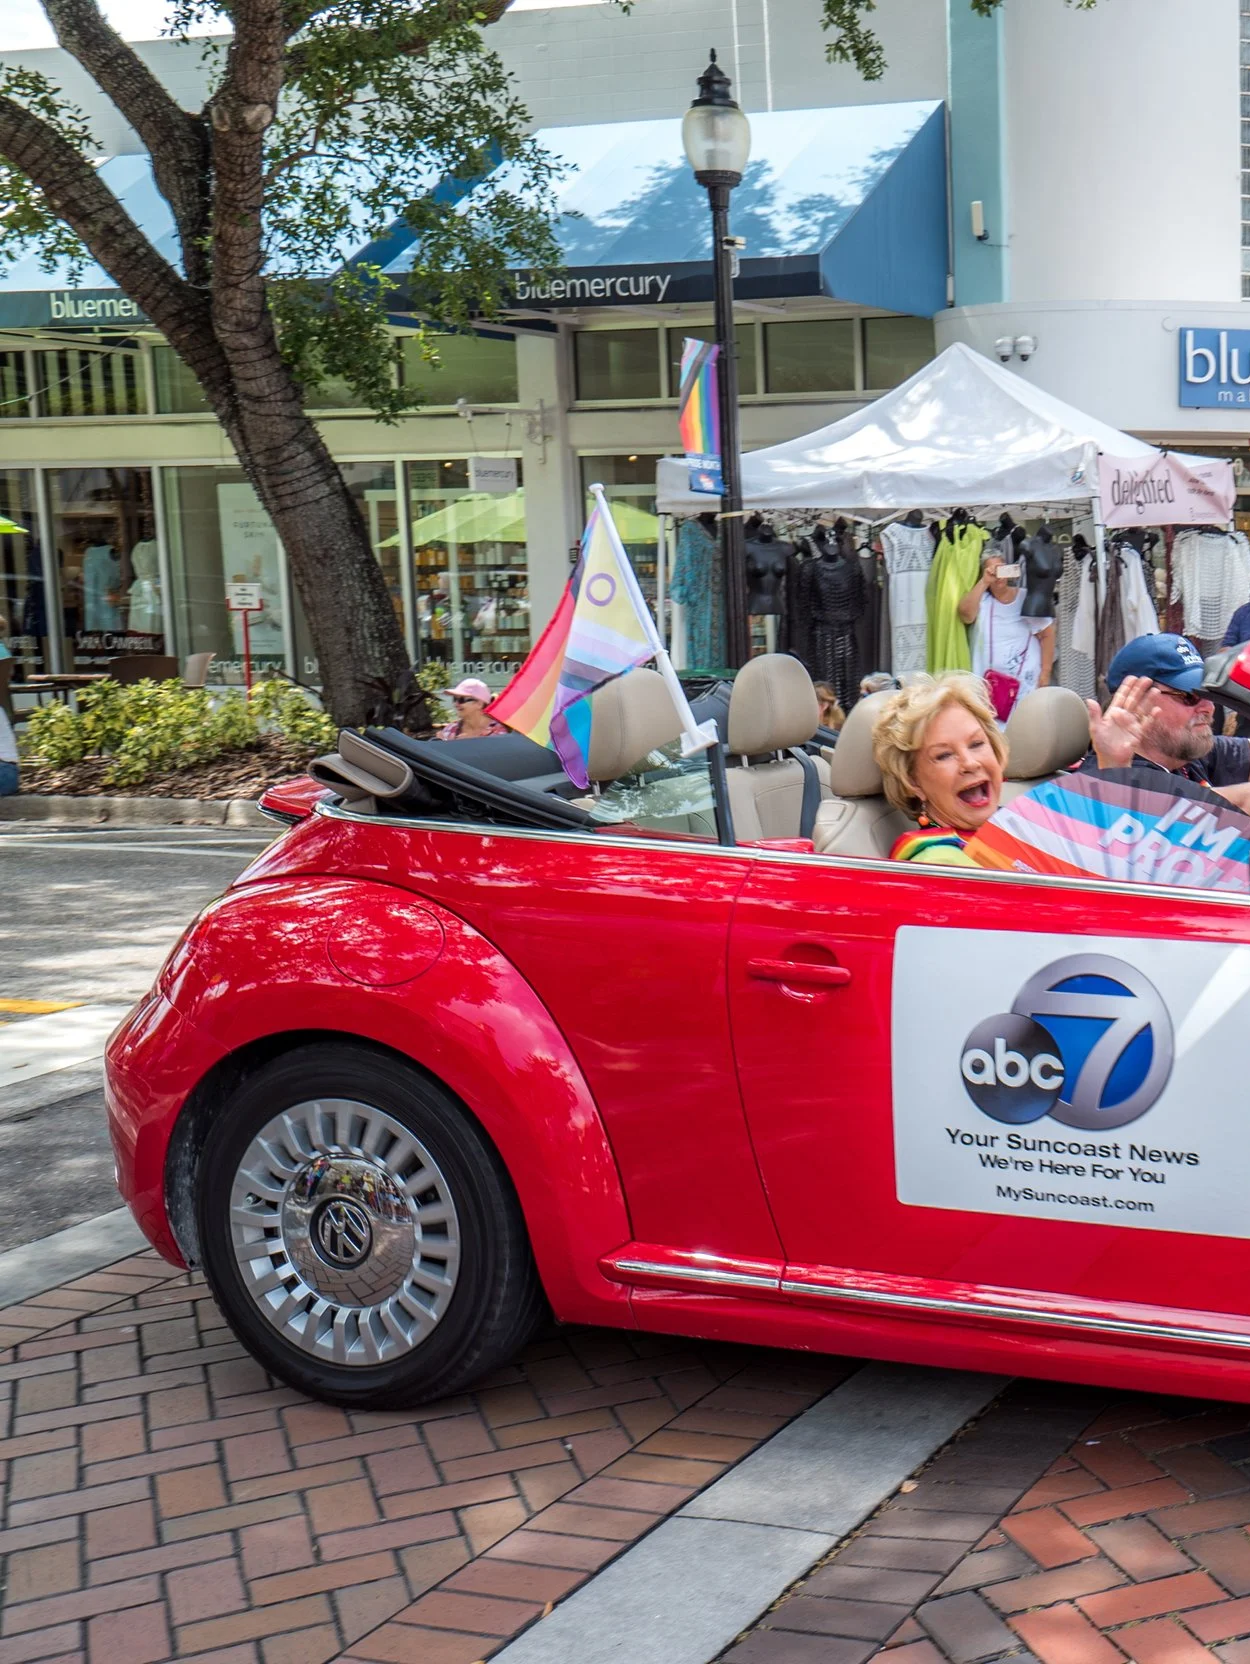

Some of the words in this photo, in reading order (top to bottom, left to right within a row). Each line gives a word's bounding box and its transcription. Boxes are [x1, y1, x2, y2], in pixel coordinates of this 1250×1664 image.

[1154, 797, 1242, 862] I'M
[961, 1037, 1065, 1090] abc
[1020, 983, 1160, 1117] 7
[945, 1128, 1000, 1148] Your
[1006, 1133, 1122, 1159] Suncoast
[1129, 1143, 1200, 1166] News
[978, 1153, 1034, 1172] We're
[1039, 1160, 1087, 1177] Here
[1092, 1164, 1124, 1181] For
[1129, 1168, 1166, 1184] You
[996, 1185, 1155, 1213] MySuncoast.com
